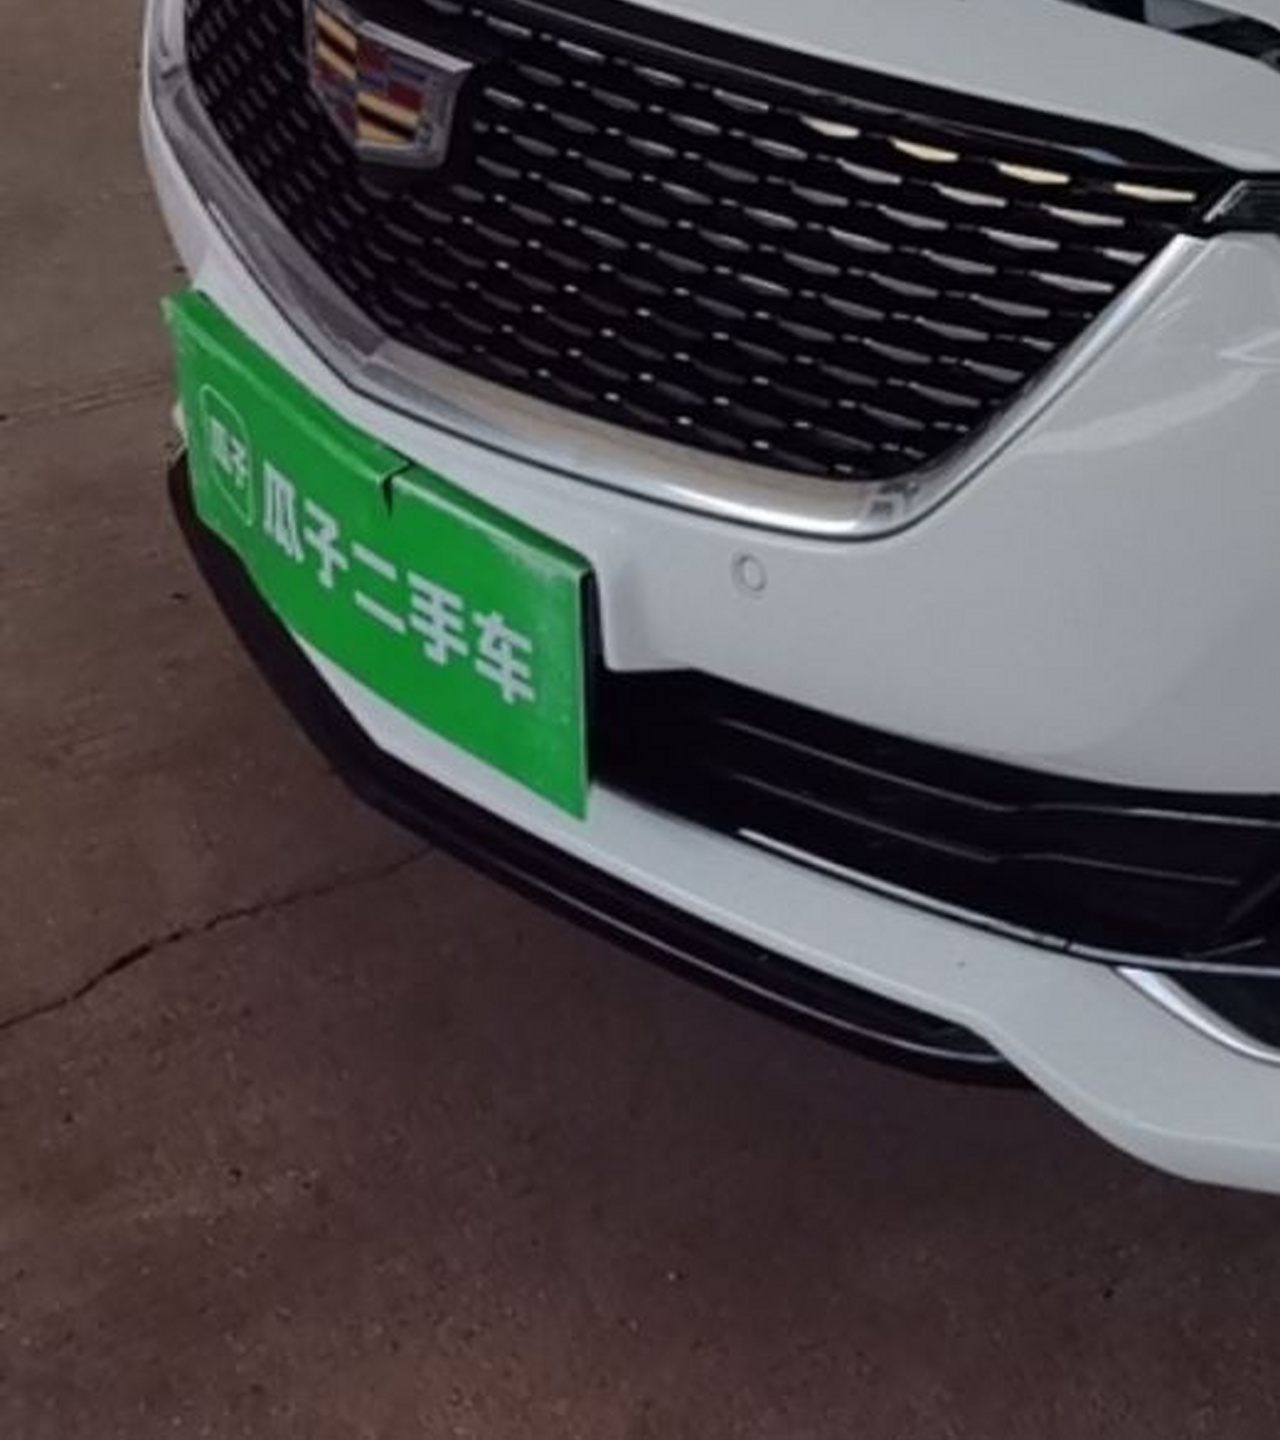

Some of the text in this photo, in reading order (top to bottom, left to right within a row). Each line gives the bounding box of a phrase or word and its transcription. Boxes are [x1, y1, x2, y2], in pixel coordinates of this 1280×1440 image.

[263, 461, 536, 705] 瓜子二手车
